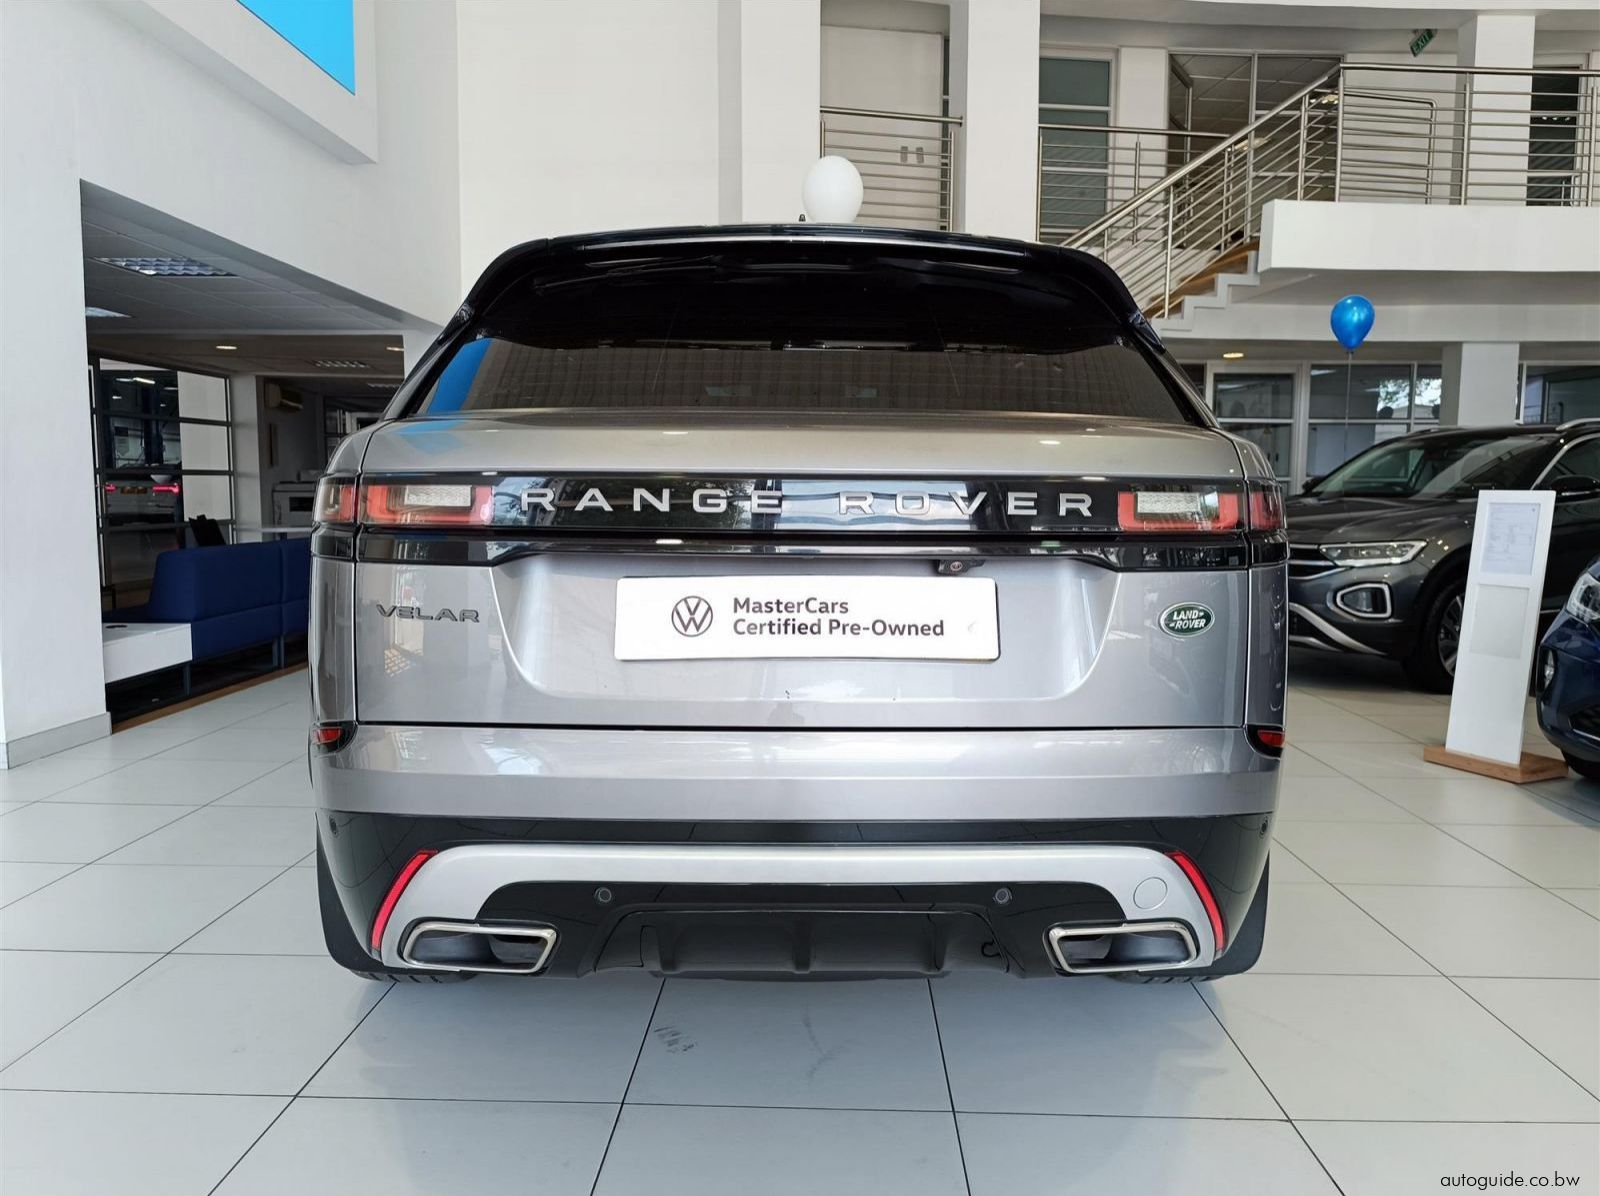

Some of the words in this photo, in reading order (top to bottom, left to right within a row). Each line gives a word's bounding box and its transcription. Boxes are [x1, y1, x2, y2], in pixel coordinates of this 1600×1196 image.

[1412, 31, 1431, 54] EXIT
[521, 488, 782, 514] RANGE
[839, 491, 1092, 517] ROVER
[376, 604, 480, 623] VELAR
[733, 597, 849, 614] MasterCars
[1173, 610, 1199, 620] LAND
[1175, 619, 1206, 629] ROVER
[733, 618, 822, 636] Certified
[829, 619, 944, 636] Pre-Owned
